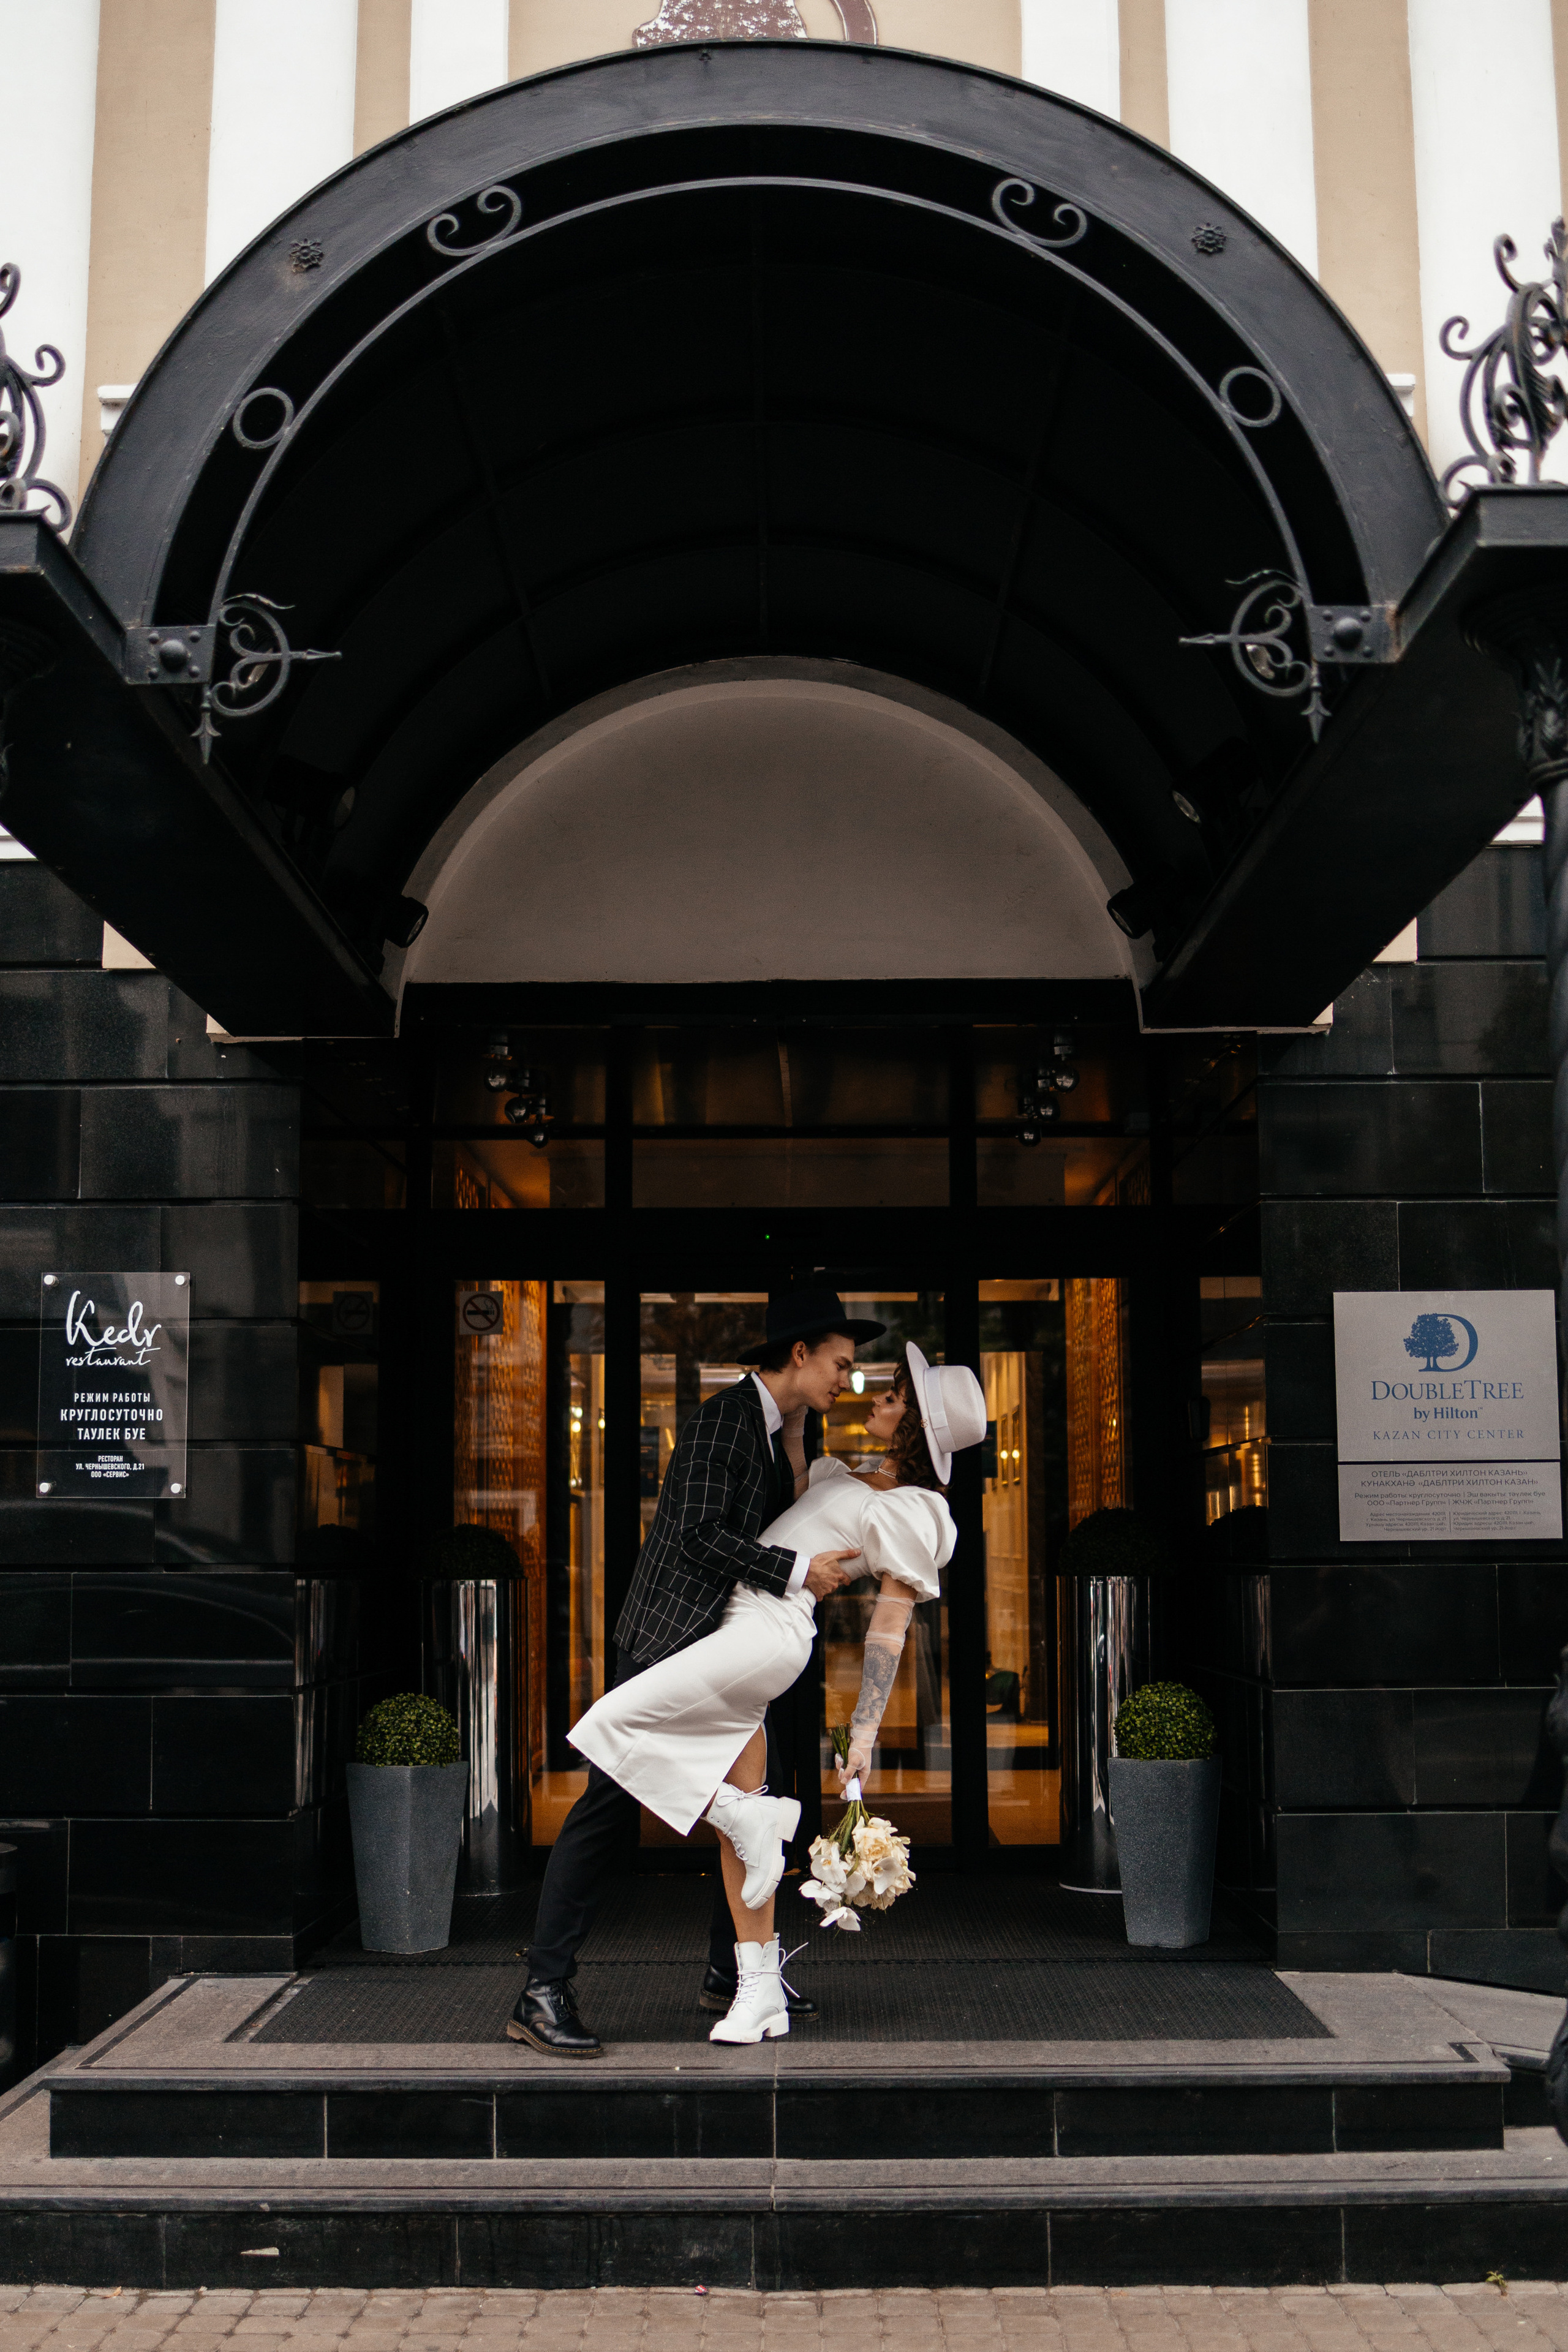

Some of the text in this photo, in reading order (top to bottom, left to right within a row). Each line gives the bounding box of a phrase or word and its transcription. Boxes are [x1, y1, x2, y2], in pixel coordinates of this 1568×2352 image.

[66, 1290, 162, 1347] Kedr
[66, 1347, 161, 1366] restaurant
[74, 1393, 150, 1402] РЕЖИМ РАБОТЫ
[61, 1409, 163, 1421] КРУГЛОСУТОЧНО
[1414, 1408, 1430, 1422] by
[77, 1428, 146, 1440] ТАУЛЕК БУЕ
[1373, 1430, 1524, 1440] KAZAN CITY CENTER
